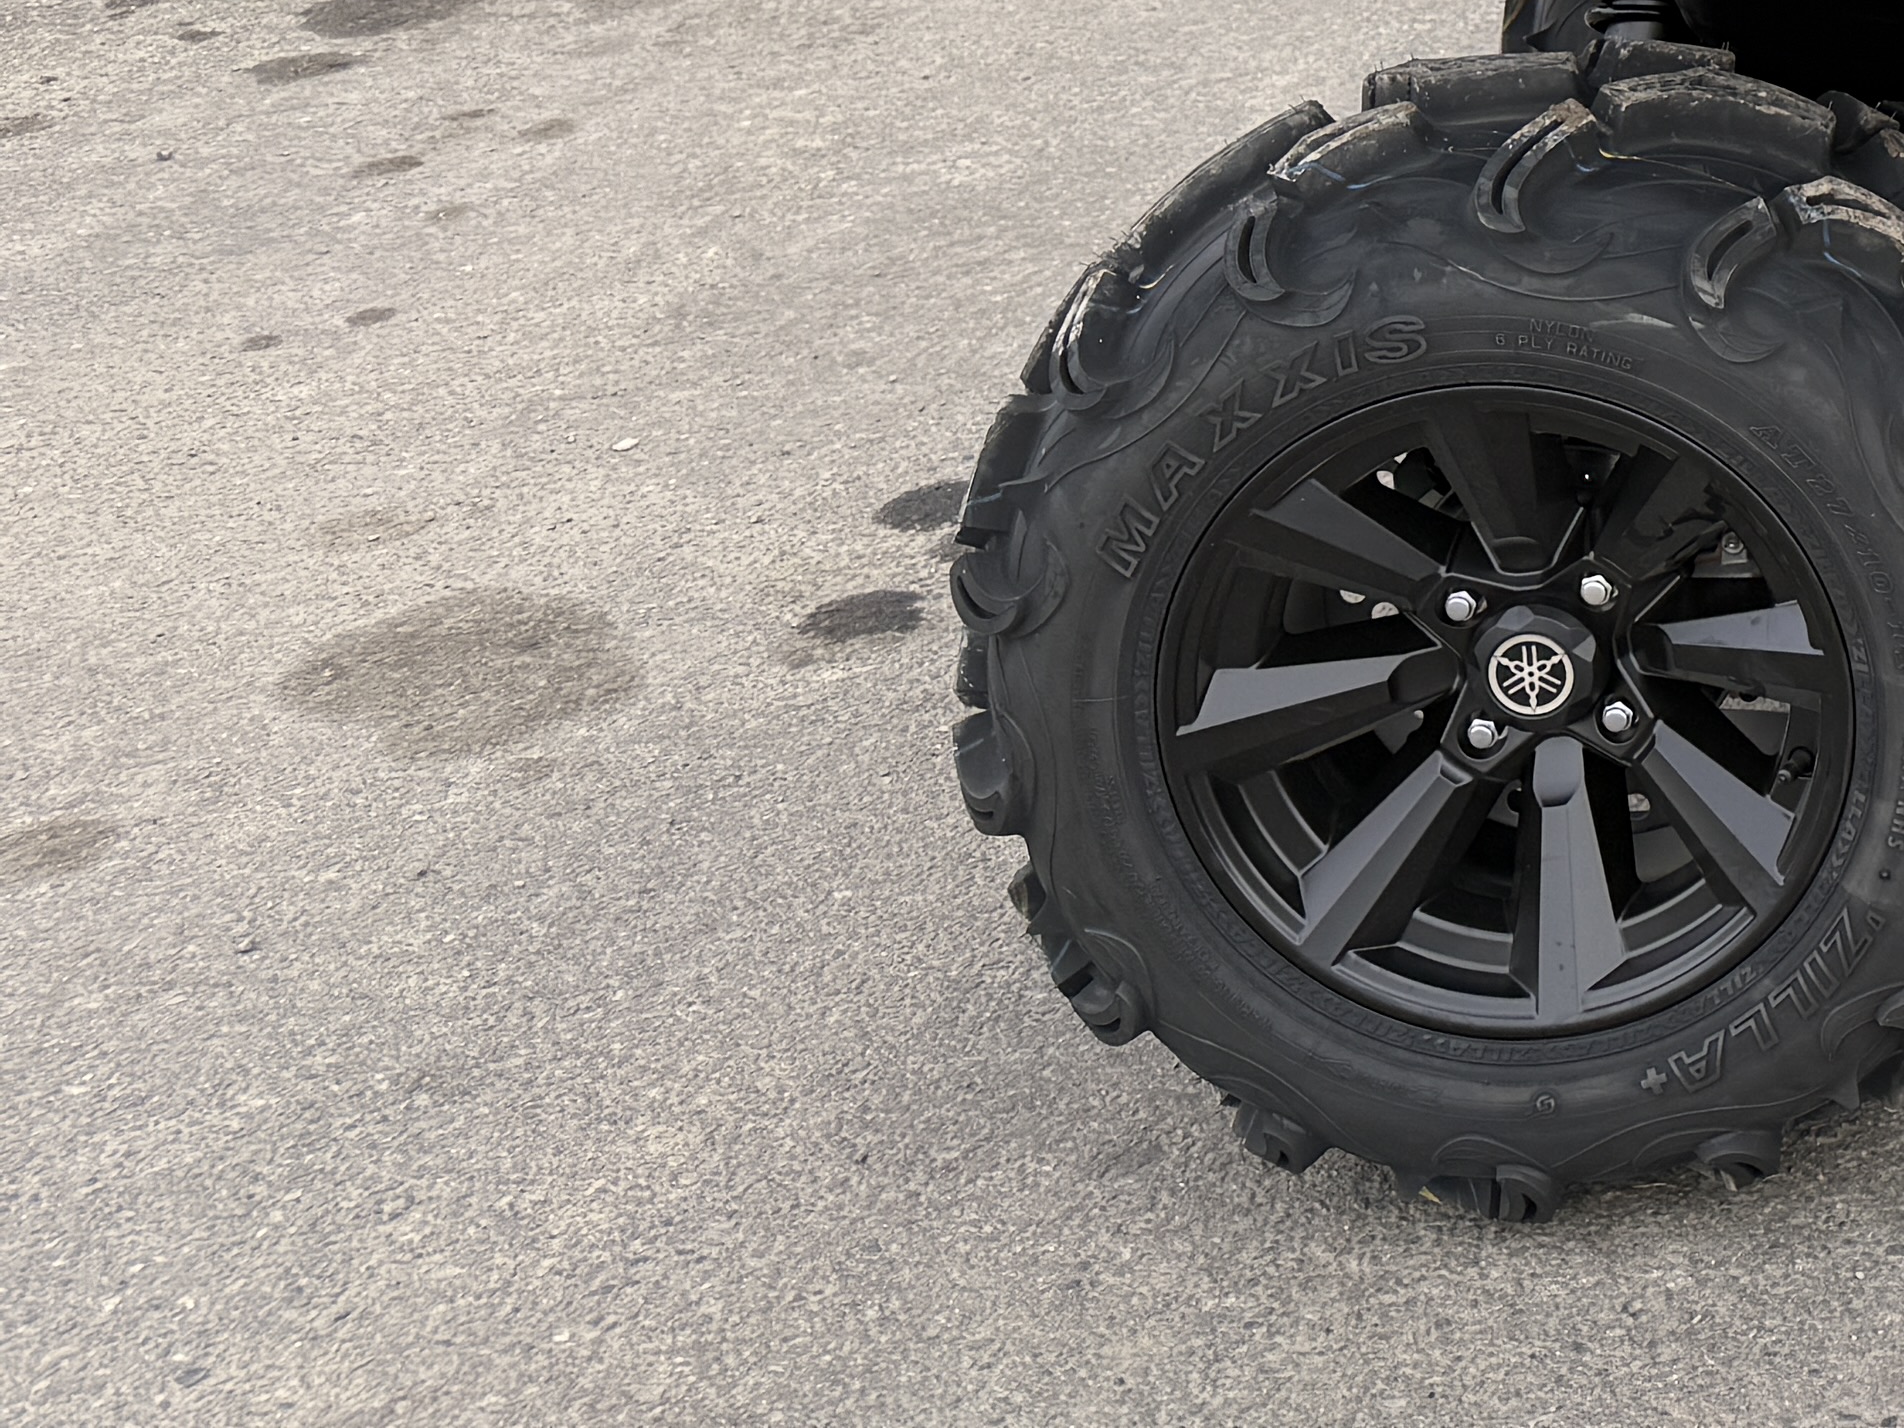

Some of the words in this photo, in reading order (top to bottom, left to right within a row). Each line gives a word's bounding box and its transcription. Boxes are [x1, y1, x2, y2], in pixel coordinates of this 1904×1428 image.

[1496, 333, 1506, 345] 6
[1518, 334, 1555, 351] PLY
[1566, 342, 1634, 370] RATING
[1096, 314, 1429, 580] MAXXIS
